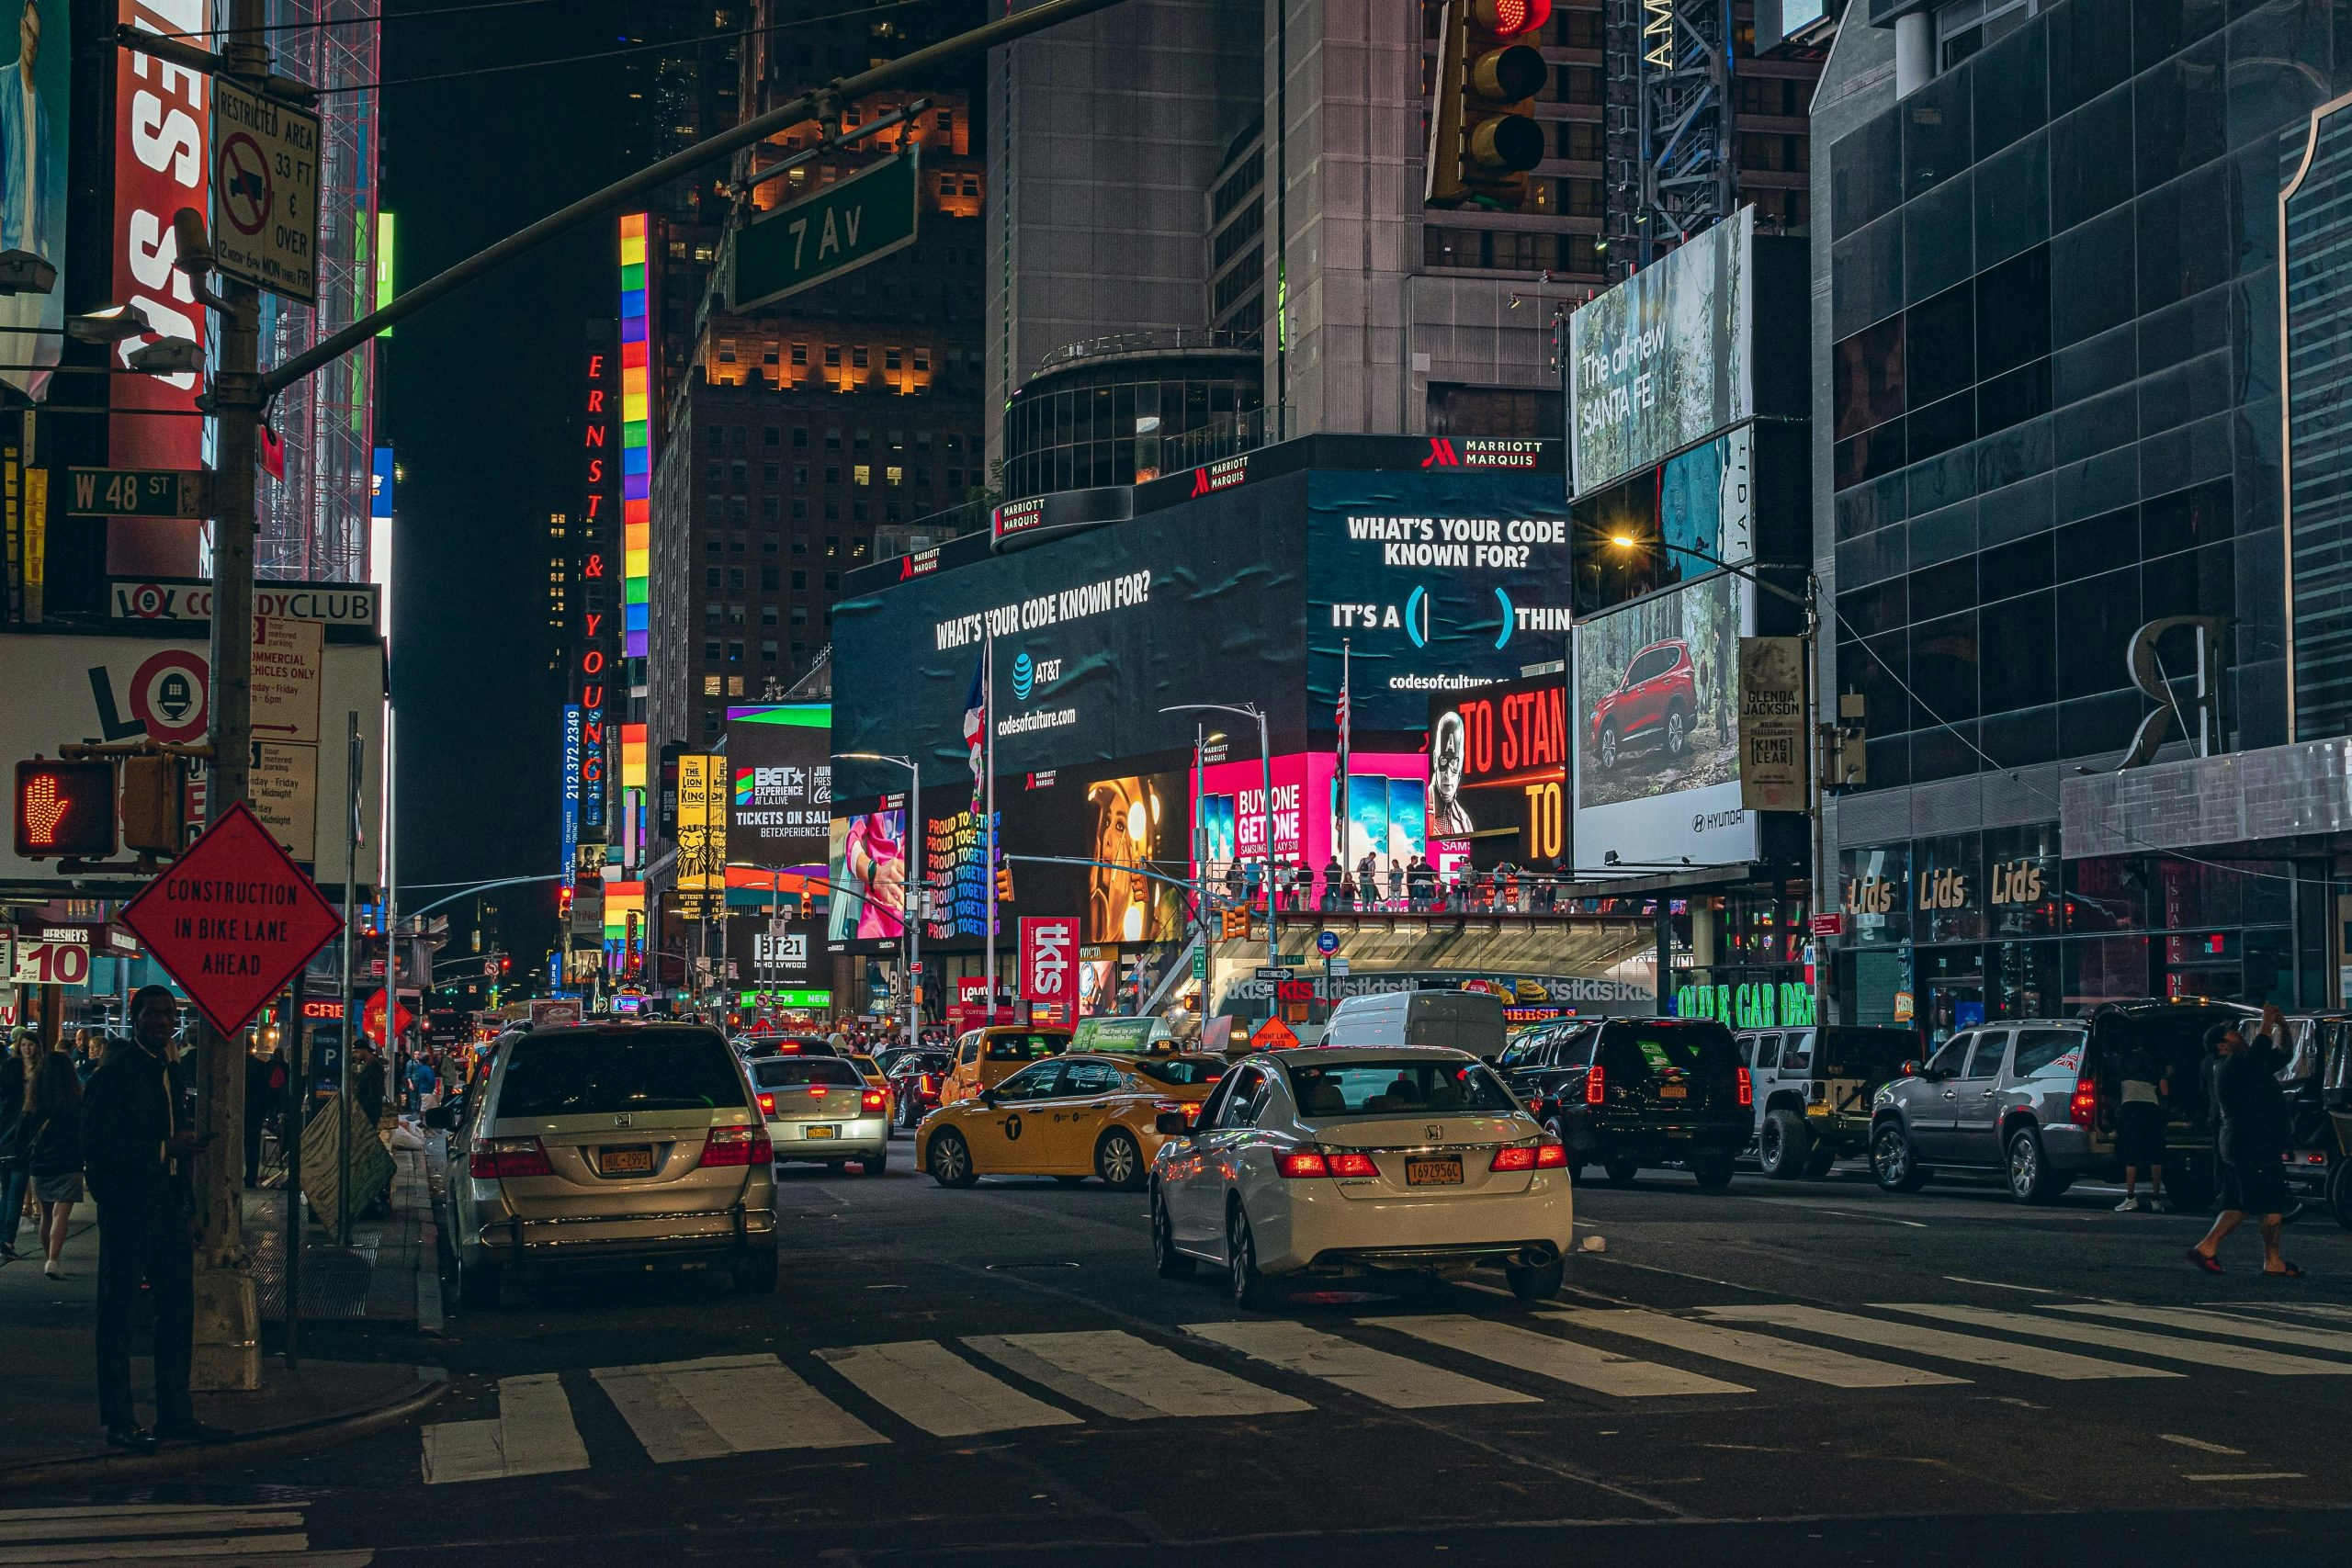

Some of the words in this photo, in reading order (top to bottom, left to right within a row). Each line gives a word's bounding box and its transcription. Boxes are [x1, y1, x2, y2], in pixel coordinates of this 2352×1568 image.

[220, 92, 278, 137] RESTRICTED
[285, 120, 312, 152] AREA
[276, 152, 290, 178] 33
[298, 160, 311, 187] FT
[277, 224, 307, 257] OVER
[788, 218, 807, 270] 7
[262, 256, 280, 278] MON
[297, 269, 311, 288] FRI
[1582, 353, 1609, 389] The
[1612, 321, 1667, 377] all-new
[1583, 384, 1631, 438] SANTA
[1633, 371, 1655, 414] FE
[585, 355, 605, 517] ERNST
[1466, 440, 1543, 453] MARRIOTT
[1212, 457, 1249, 474] MARRIOTT
[1466, 454, 1533, 466] MARQUIS
[1212, 471, 1244, 488] MARQUIS
[75, 474, 95, 509] W
[106, 474, 138, 511] 48
[149, 476, 170, 495] ST
[1004, 499, 1045, 516] MARRIOTT
[1004, 513, 1039, 532] MARQUIS
[1348, 517, 1434, 541] WHAT'S
[1440, 519, 1501, 542] YOUR
[1507, 521, 1566, 543] CODE
[914, 547, 941, 562] MARRIOTT
[1385, 544, 1468, 567] KNOWN
[1476, 546, 1530, 568] FOR?
[585, 553, 604, 577] &
[914, 559, 937, 573] MARQUIS
[936, 612, 981, 650] WHAT'S
[984, 603, 1019, 638] YOUR
[1022, 595, 1057, 630] CODE
[1059, 581, 1111, 619] KNOWN
[1114, 570, 1151, 608] FOR?
[1333, 604, 1377, 627] IT'S
[1383, 605, 1400, 627] A
[1515, 608, 1572, 631] THIN
[269, 622, 284, 630] hour
[268, 631, 297, 640] metered
[268, 640, 293, 649] parking
[252, 665, 288, 678] EHICLES
[291, 668, 315, 680] ONLY
[1035, 659, 1061, 684] AT&T
[277, 684, 299, 696] Friday
[582, 614, 604, 782] YOUNG
[1748, 691, 1795, 703] GLENDA
[265, 694, 282, 705] 6pm
[1744, 703, 1800, 716] JACKSON
[998, 707, 1076, 736] codesofculture.com
[1459, 700, 1493, 774] TO
[1756, 739, 1787, 750] KING
[566, 710, 580, 799] 212.372.2349
[1204, 744, 1228, 753] MARRIOTT
[265, 756, 293, 764] metered
[1204, 753, 1226, 762] MARQUIS
[1756, 752, 1787, 763] LEAR
[264, 764, 289, 773] parking
[754, 767, 796, 786] BET
[1035, 770, 1057, 779] MARRIOTT
[276, 778, 299, 788] Friday
[683, 776, 702, 788] LION
[1035, 779, 1054, 787] MARQUIS
[261, 789, 291, 800] Midnight
[681, 789, 705, 803] KING
[754, 786, 804, 796] EXPERIENCE
[888, 793, 905, 801] MARRIOTT
[754, 796, 762, 805] AT
[775, 796, 788, 805] LIVE
[888, 800, 903, 808] MARQUIS
[1239, 788, 1266, 816] BUY
[1272, 784, 1300, 812] ONE
[261, 816, 291, 826] Midnight
[736, 811, 784, 826] TICKETS
[786, 811, 802, 825] ON
[929, 817, 956, 835] PROUD
[1526, 782, 1561, 859] TO
[1707, 809, 1745, 829] HYUNDAI
[1238, 816, 1267, 844] GET
[1272, 811, 1300, 841] ONE
[926, 836, 953, 852] PROUD
[1240, 843, 1267, 855] SAMSUNG
[1288, 840, 1298, 851] S10
[928, 852, 956, 870] PROUD
[1920, 867, 1964, 910] Lids
[1992, 861, 2041, 905] Lids
[167, 879, 297, 907] CONSTRUCTION
[1850, 874, 1891, 915] Lids
[43, 928, 88, 942] HERSHEY'S
[175, 919, 191, 939] IN
[198, 919, 237, 941] BIKE
[244, 921, 288, 942] LANE
[928, 921, 955, 940] PROUD
[28, 944, 89, 983] 10
[202, 953, 261, 976] AHEAD
[1035, 923, 1069, 995] tkts
[1678, 985, 1730, 1028] OLIVE
[324, 1049, 336, 1066] P
[1412, 1163, 1459, 1179] T692956C
